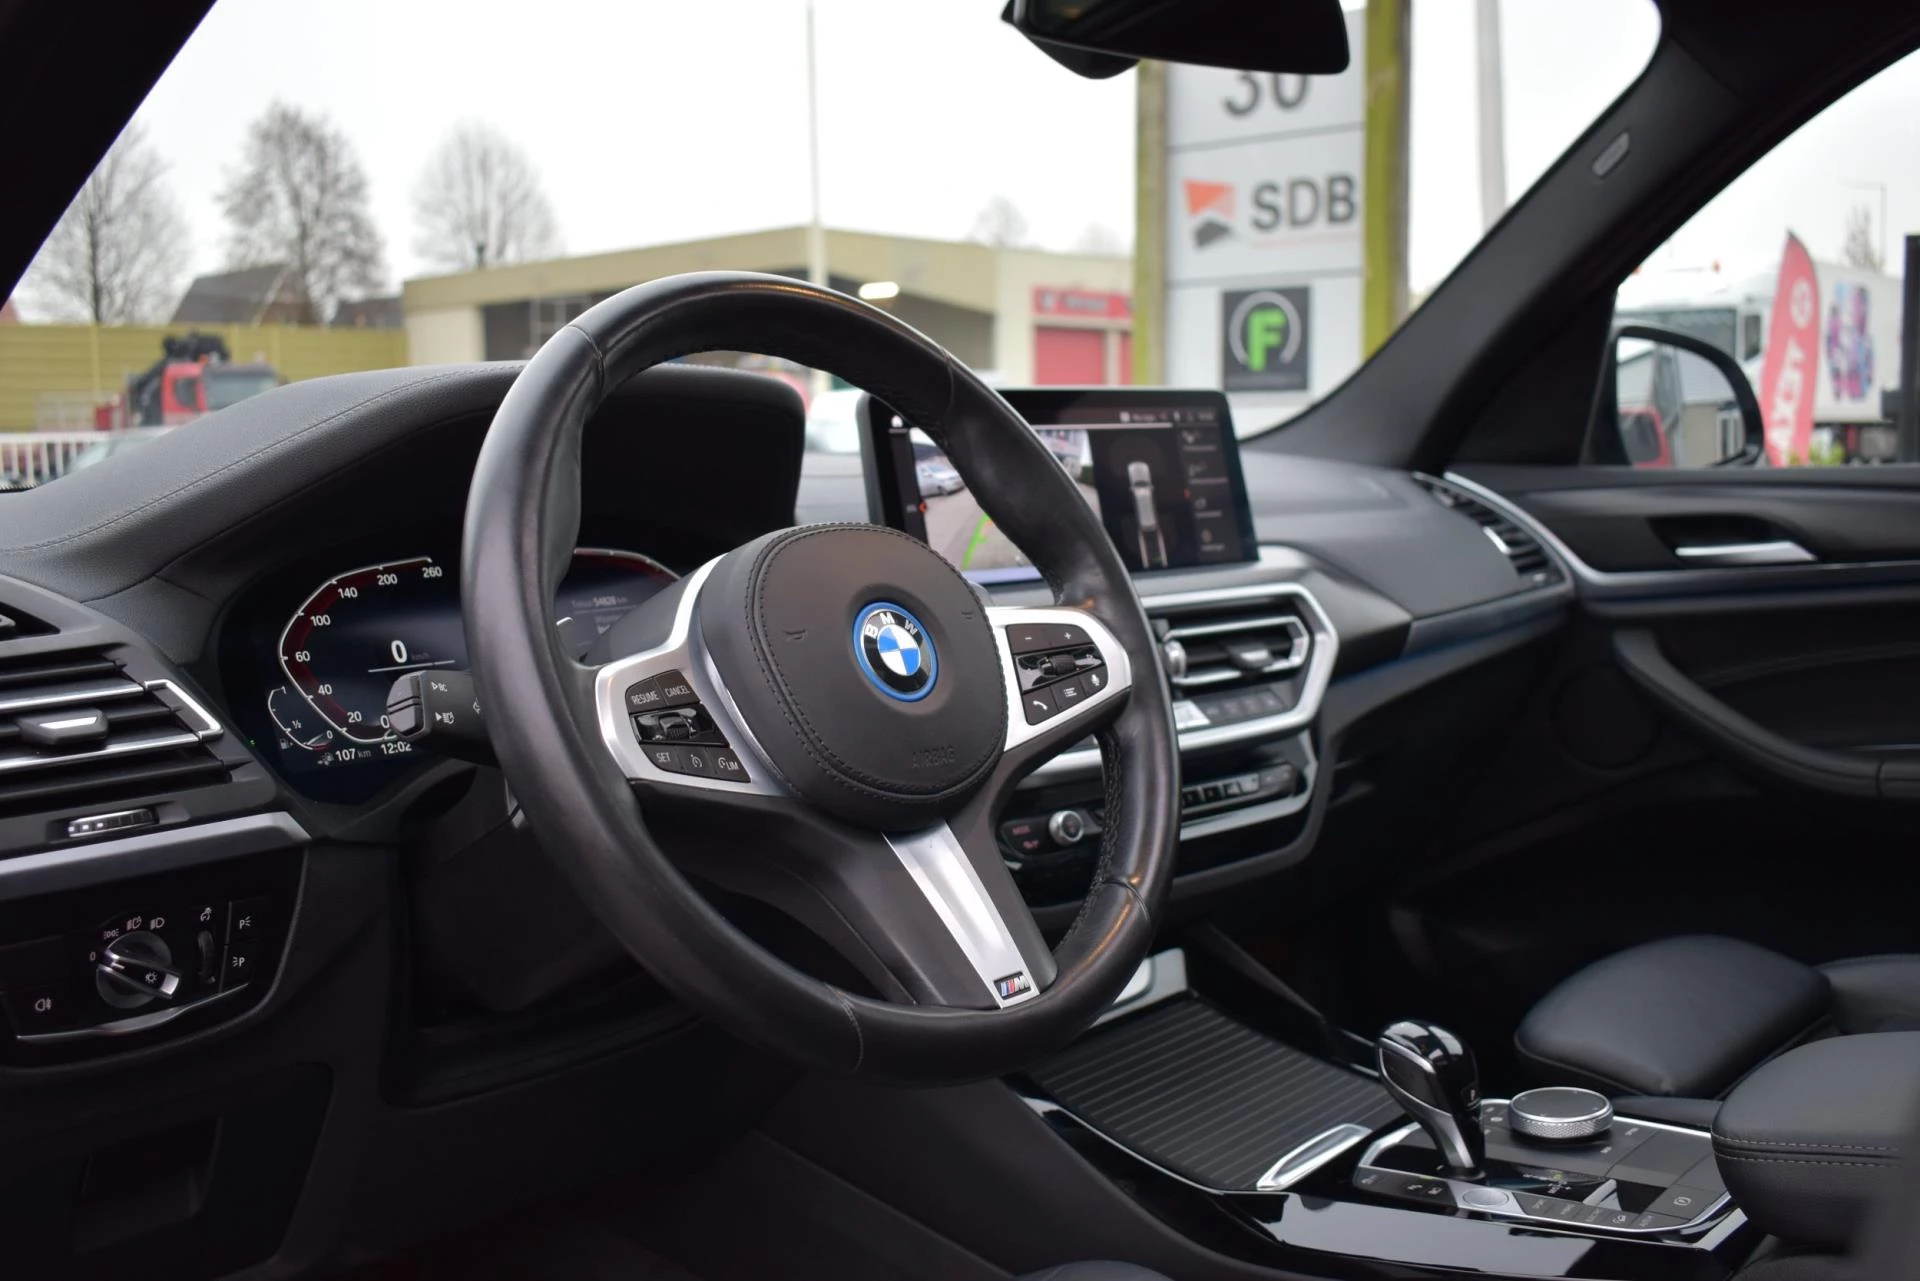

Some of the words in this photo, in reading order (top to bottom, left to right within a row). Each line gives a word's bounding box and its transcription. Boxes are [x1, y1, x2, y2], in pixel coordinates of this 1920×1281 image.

[1251, 173, 1357, 232] SDB
[1247, 308, 1287, 372] F
[422, 566, 443, 578] 260
[376, 573, 398, 585] 200
[338, 587, 358, 599] 140
[310, 614, 331, 626] 100
[865, 611, 918, 640] BMW
[295, 650, 310, 663] 60
[391, 639, 408, 664] 0
[318, 683, 333, 696] 40
[664, 685, 690, 698] CANCEL
[631, 690, 660, 705] RESUME
[347, 710, 362, 723] 20
[380, 714, 390, 729] 0
[326, 730, 334, 739] 0
[335, 748, 356, 761] 107
[357, 749, 372, 758] km
[380, 741, 412, 755] 12:02
[656, 752, 671, 763] SET
[911, 744, 956, 771] AIRBAG
[726, 760, 739, 770] LIM
[239, 919, 246, 929] P
[238, 956, 245, 967] P
